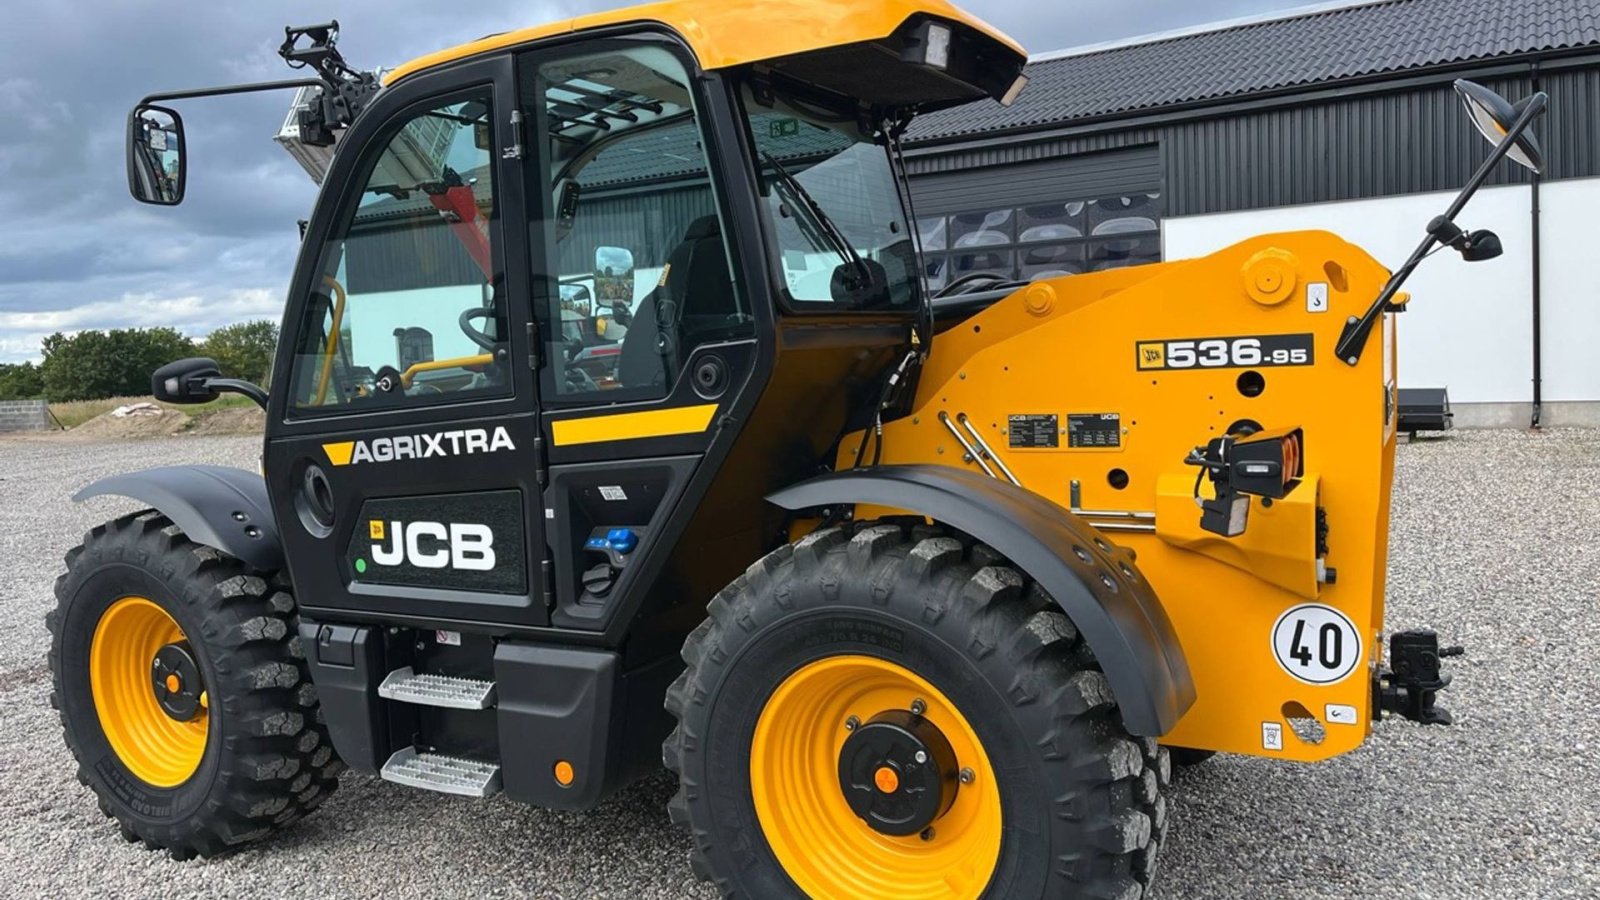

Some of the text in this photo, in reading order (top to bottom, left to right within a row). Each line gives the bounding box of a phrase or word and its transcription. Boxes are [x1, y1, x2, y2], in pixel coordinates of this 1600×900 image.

[351, 426, 515, 465] AGRIXTRA
[370, 520, 496, 571] JCB
[1289, 619, 1343, 670] 40
